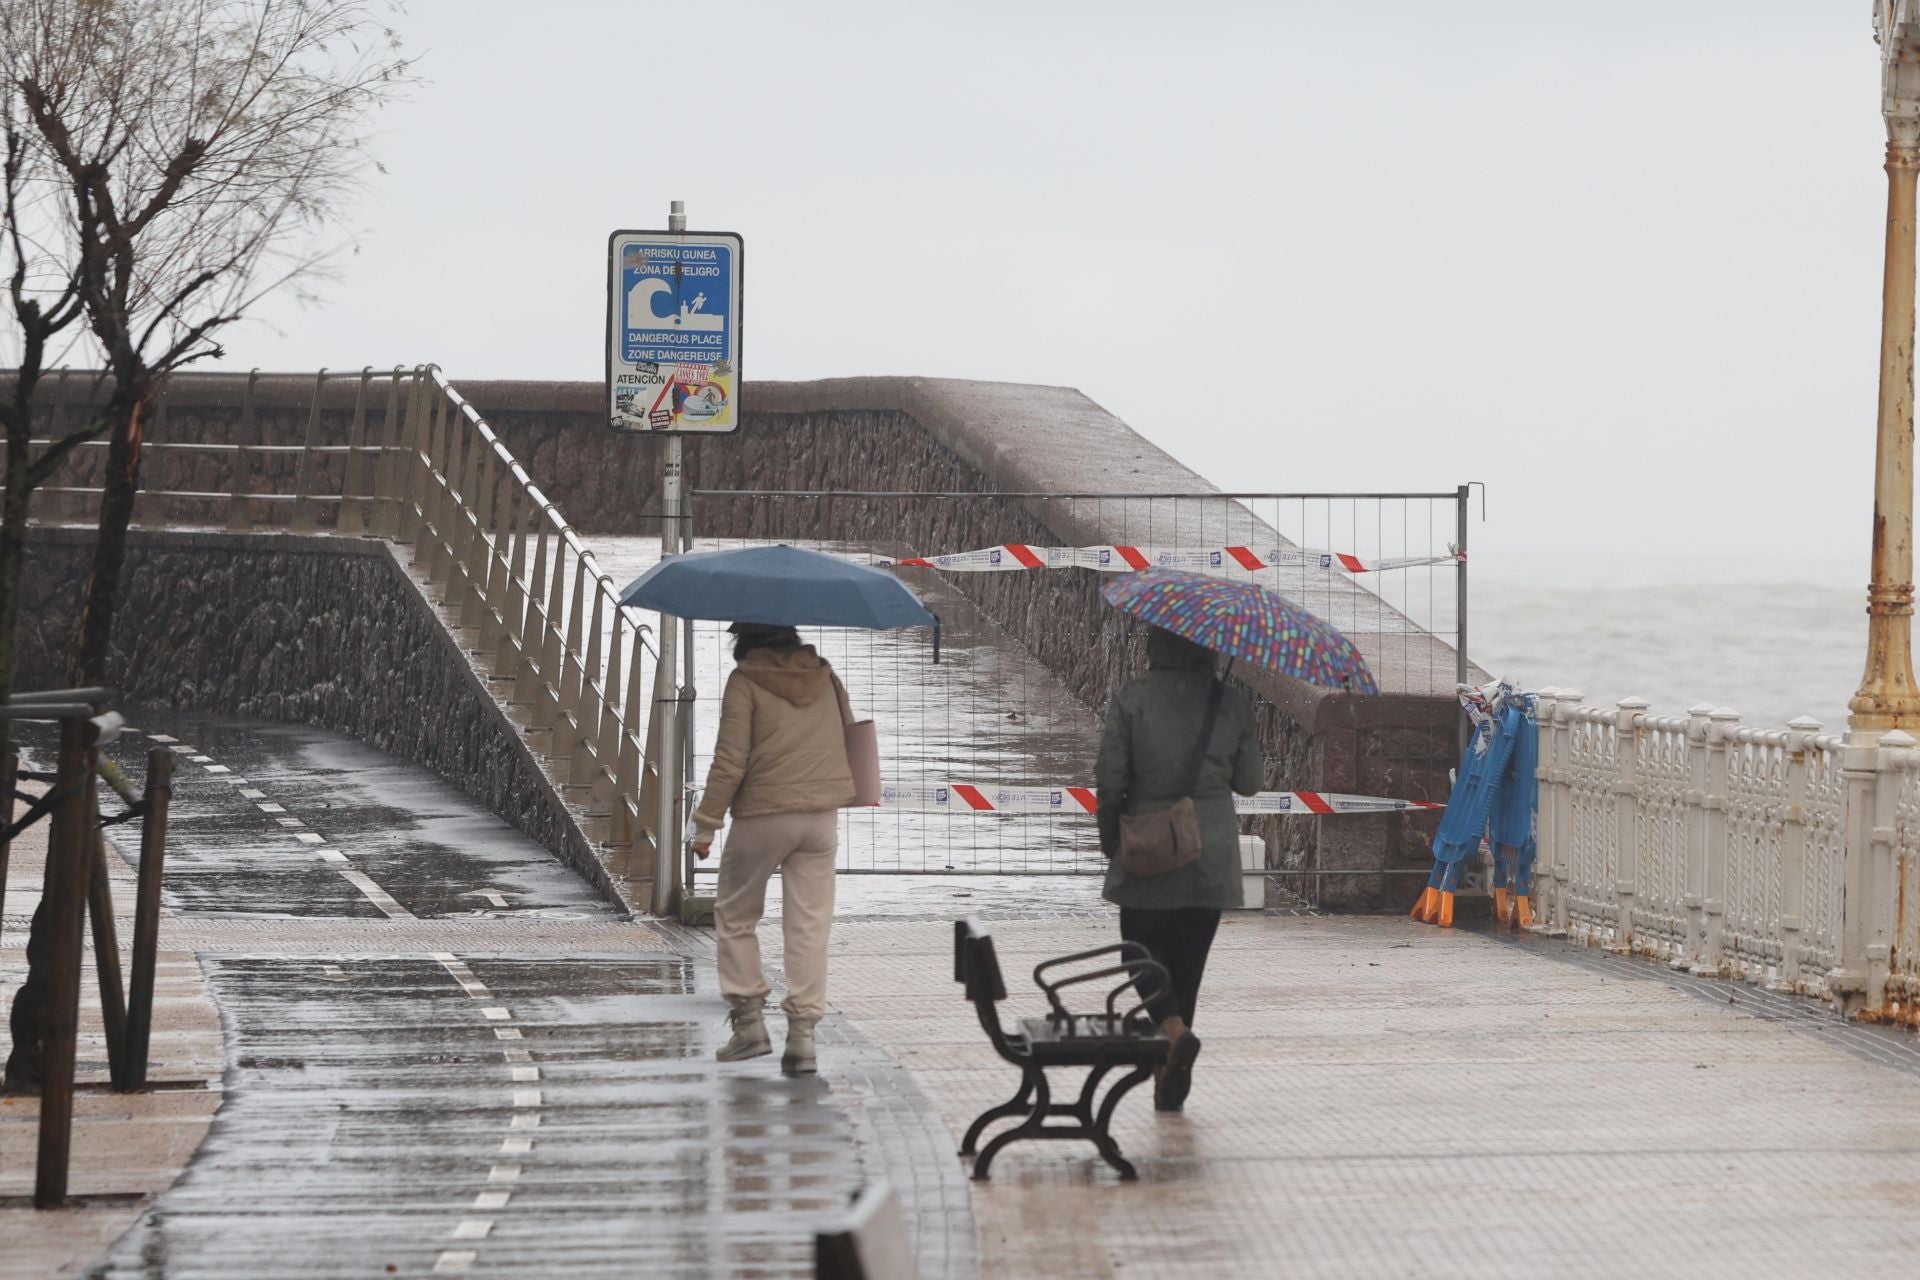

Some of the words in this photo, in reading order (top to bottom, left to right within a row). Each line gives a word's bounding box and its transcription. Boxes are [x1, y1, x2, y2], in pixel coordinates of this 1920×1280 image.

[682, 249, 717, 261] GUNEA
[633, 265, 661, 275] ZONA
[662, 265, 676, 275] DE
[628, 333, 689, 344] DANGEROUS
[691, 334, 723, 345] PLACE
[627, 349, 655, 360] ZONE
[657, 350, 723, 361] DANGEREUSE
